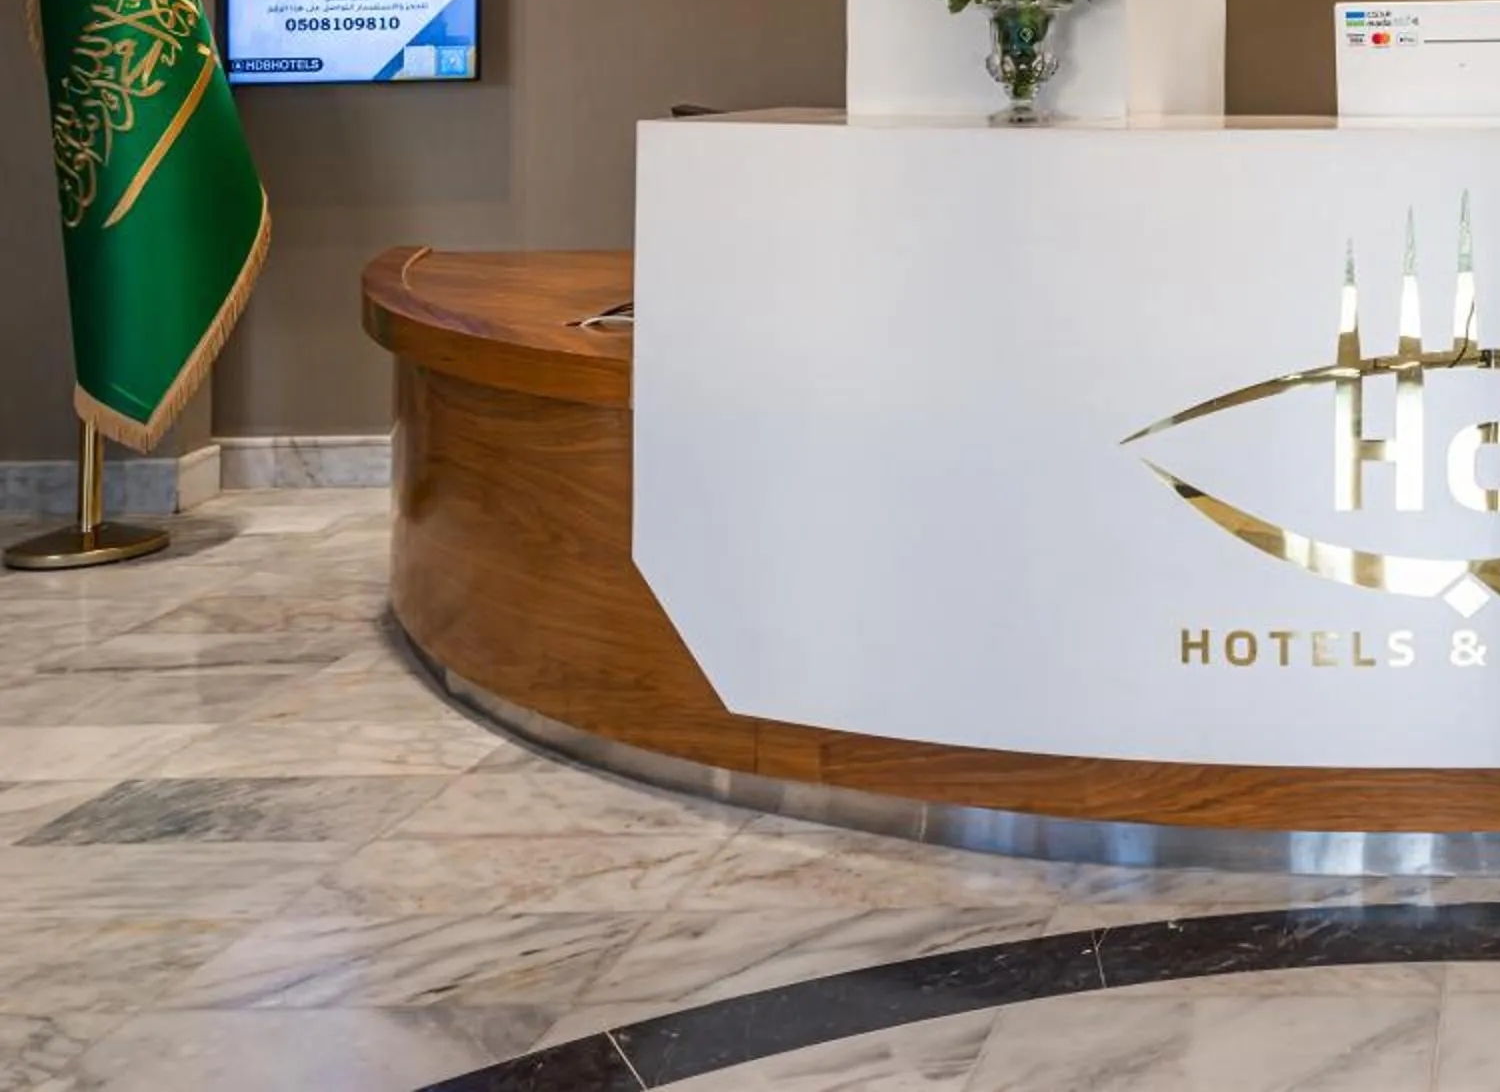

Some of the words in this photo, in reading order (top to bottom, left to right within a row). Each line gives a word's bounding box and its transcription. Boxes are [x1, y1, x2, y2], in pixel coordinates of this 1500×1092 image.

[285, 17, 401, 32] 0508109810
[1180, 627, 1417, 668] HOTELS
[1449, 629, 1488, 668] &
